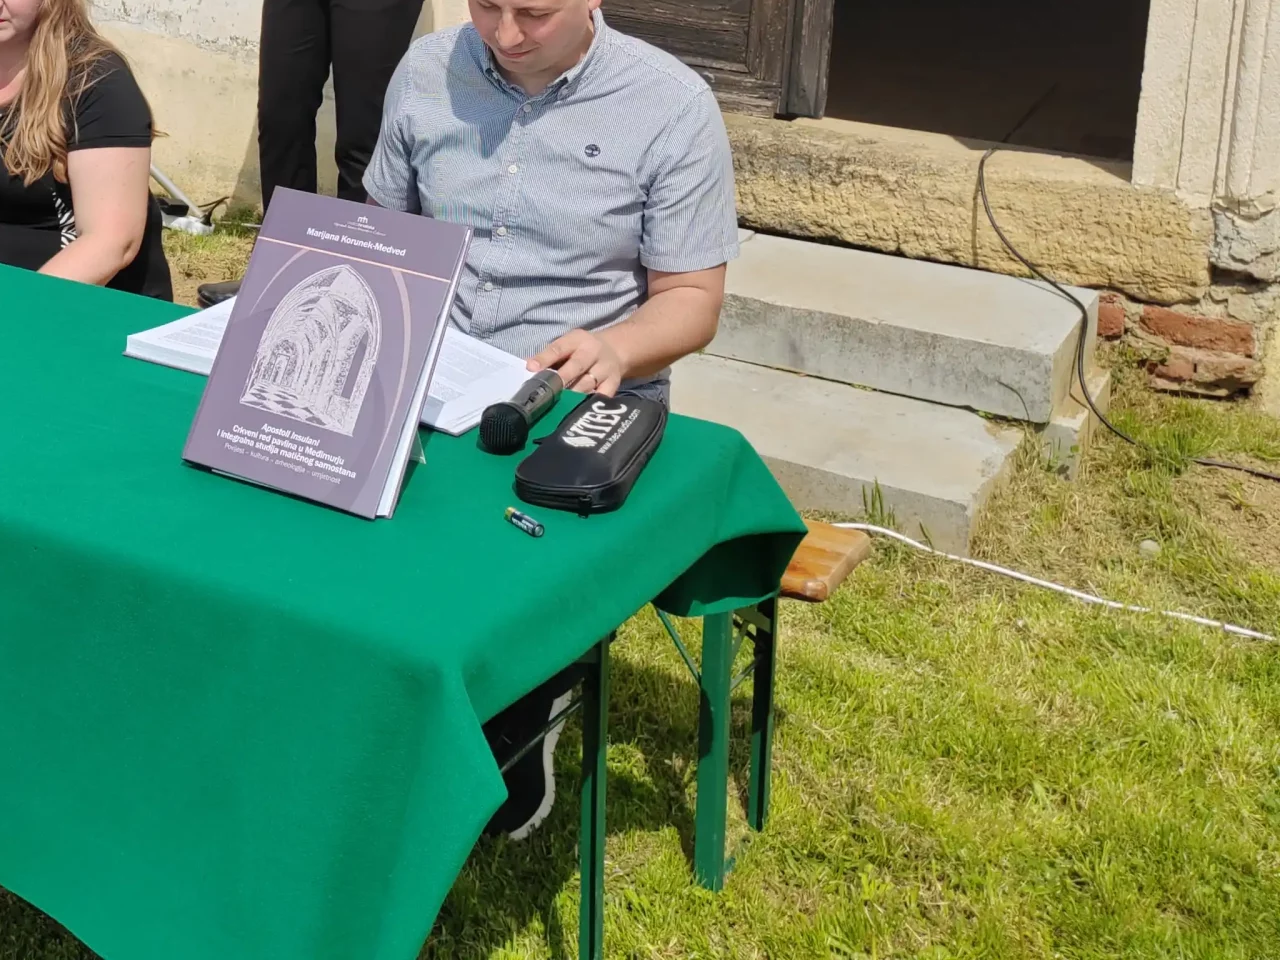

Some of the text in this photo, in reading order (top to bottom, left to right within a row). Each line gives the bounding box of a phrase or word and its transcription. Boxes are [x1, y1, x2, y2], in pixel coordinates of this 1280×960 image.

[306, 227, 340, 242] Marijana
[340, 235, 407, 257] Korunek-Medved
[232, 424, 259, 439] Crkveni
[259, 432, 272, 442] red
[271, 437, 298, 450] pavlina
[254, 441, 279, 455] studija
[314, 459, 357, 479] samostana
